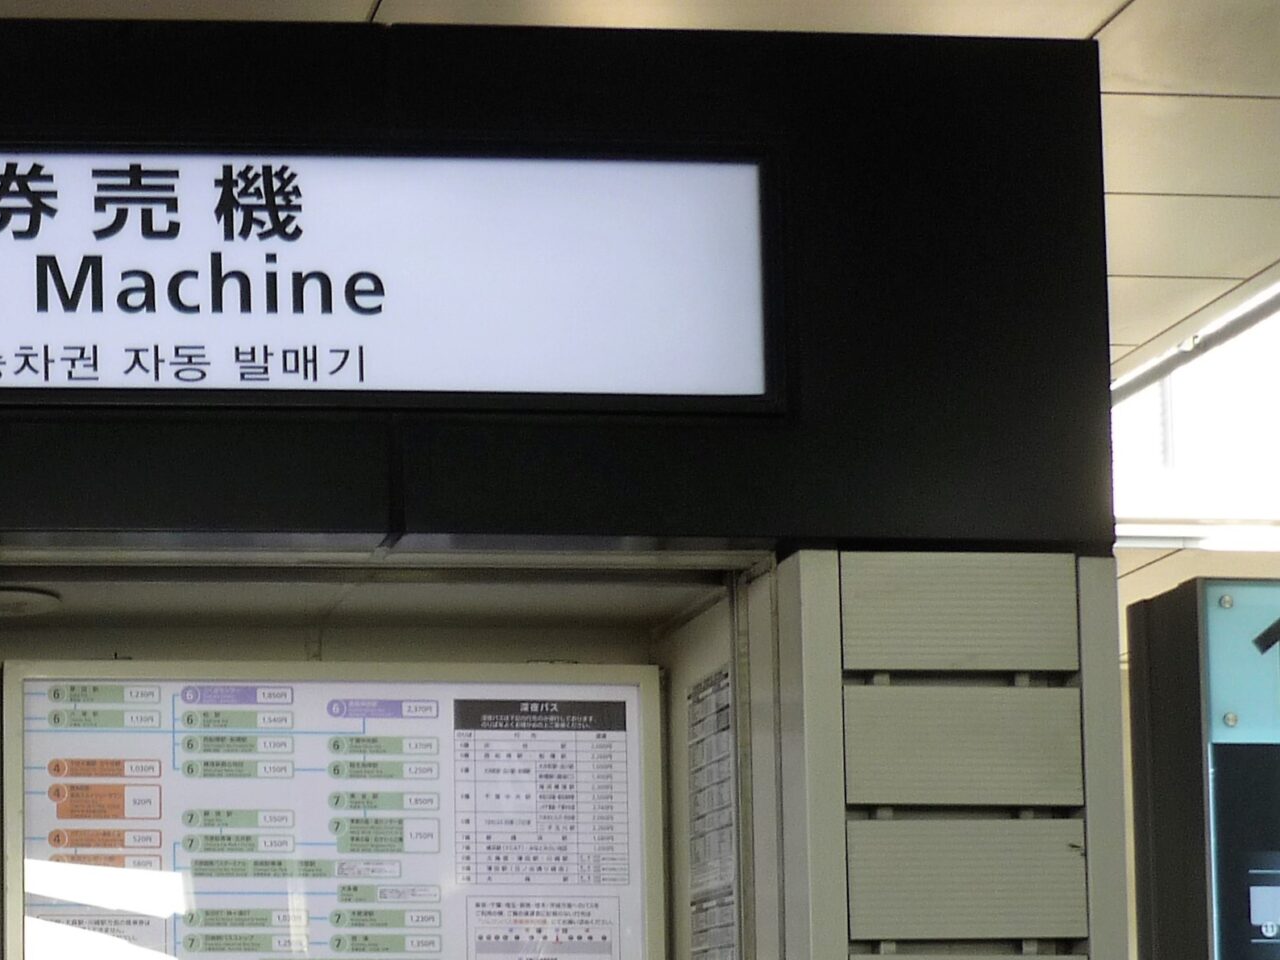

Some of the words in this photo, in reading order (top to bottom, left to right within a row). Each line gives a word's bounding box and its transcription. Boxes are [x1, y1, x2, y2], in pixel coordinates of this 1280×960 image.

[35, 251, 386, 316] Machine
[123, 345, 211, 382] 자동
[233, 345, 366, 382] 발매기
[519, 702, 559, 712] 深夜バス
